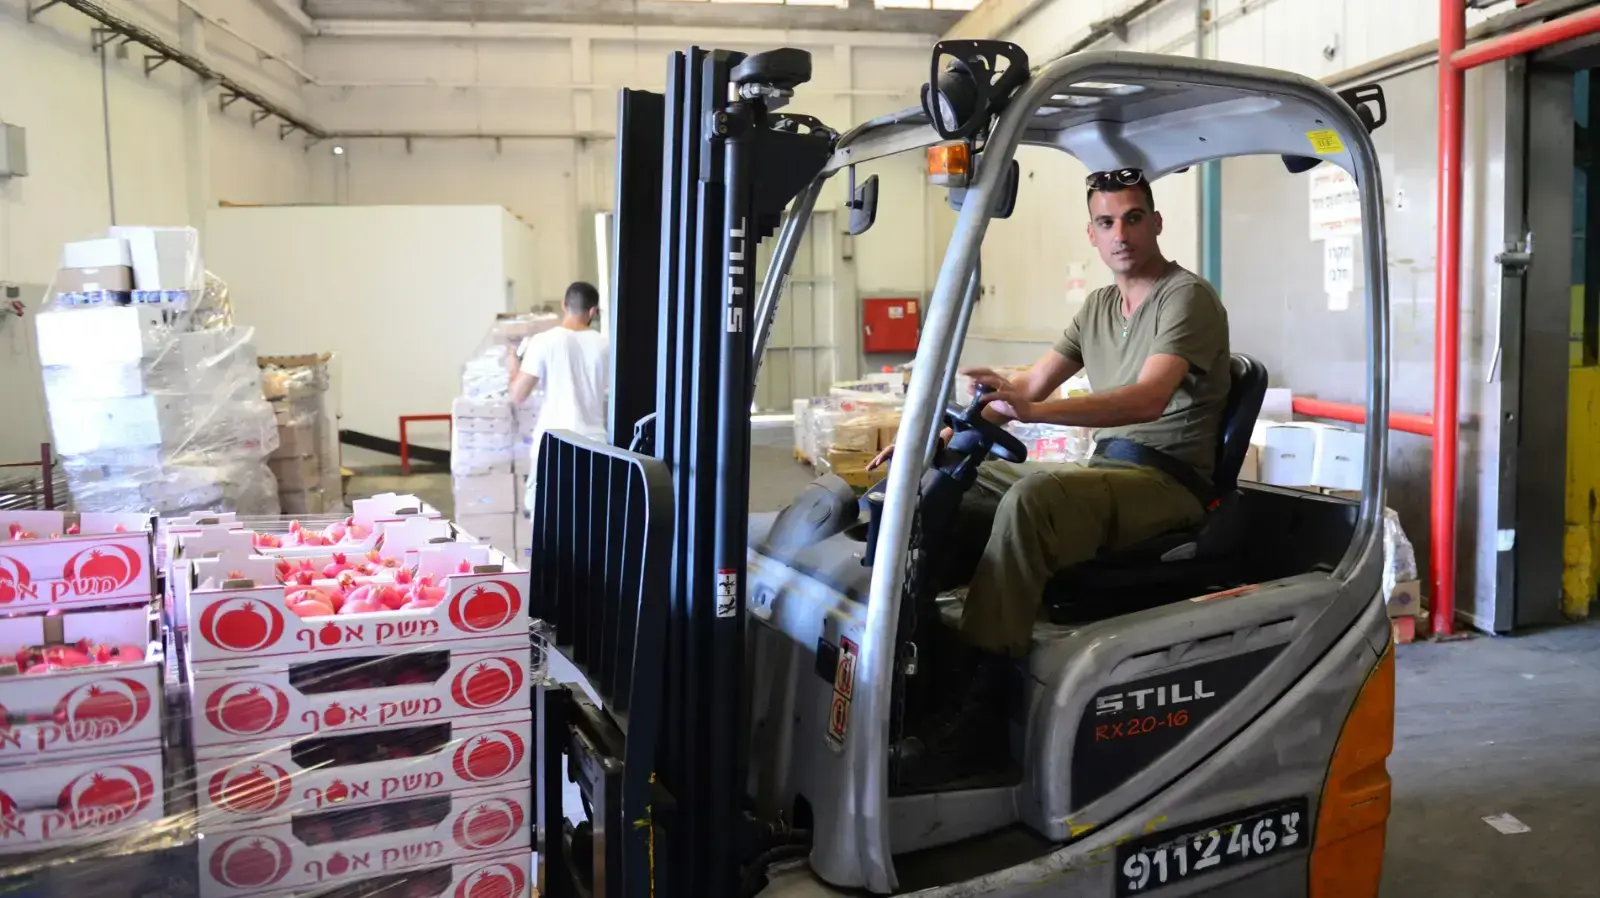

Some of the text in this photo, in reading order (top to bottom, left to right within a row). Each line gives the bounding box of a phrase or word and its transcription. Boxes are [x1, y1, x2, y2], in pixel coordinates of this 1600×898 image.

[726, 216, 746, 332] STILL
[375, 617, 439, 645] משק
[378, 695, 442, 725] משק
[1096, 679, 1216, 716] STILL
[380, 771, 444, 799] משק
[382, 838, 444, 867] משק
